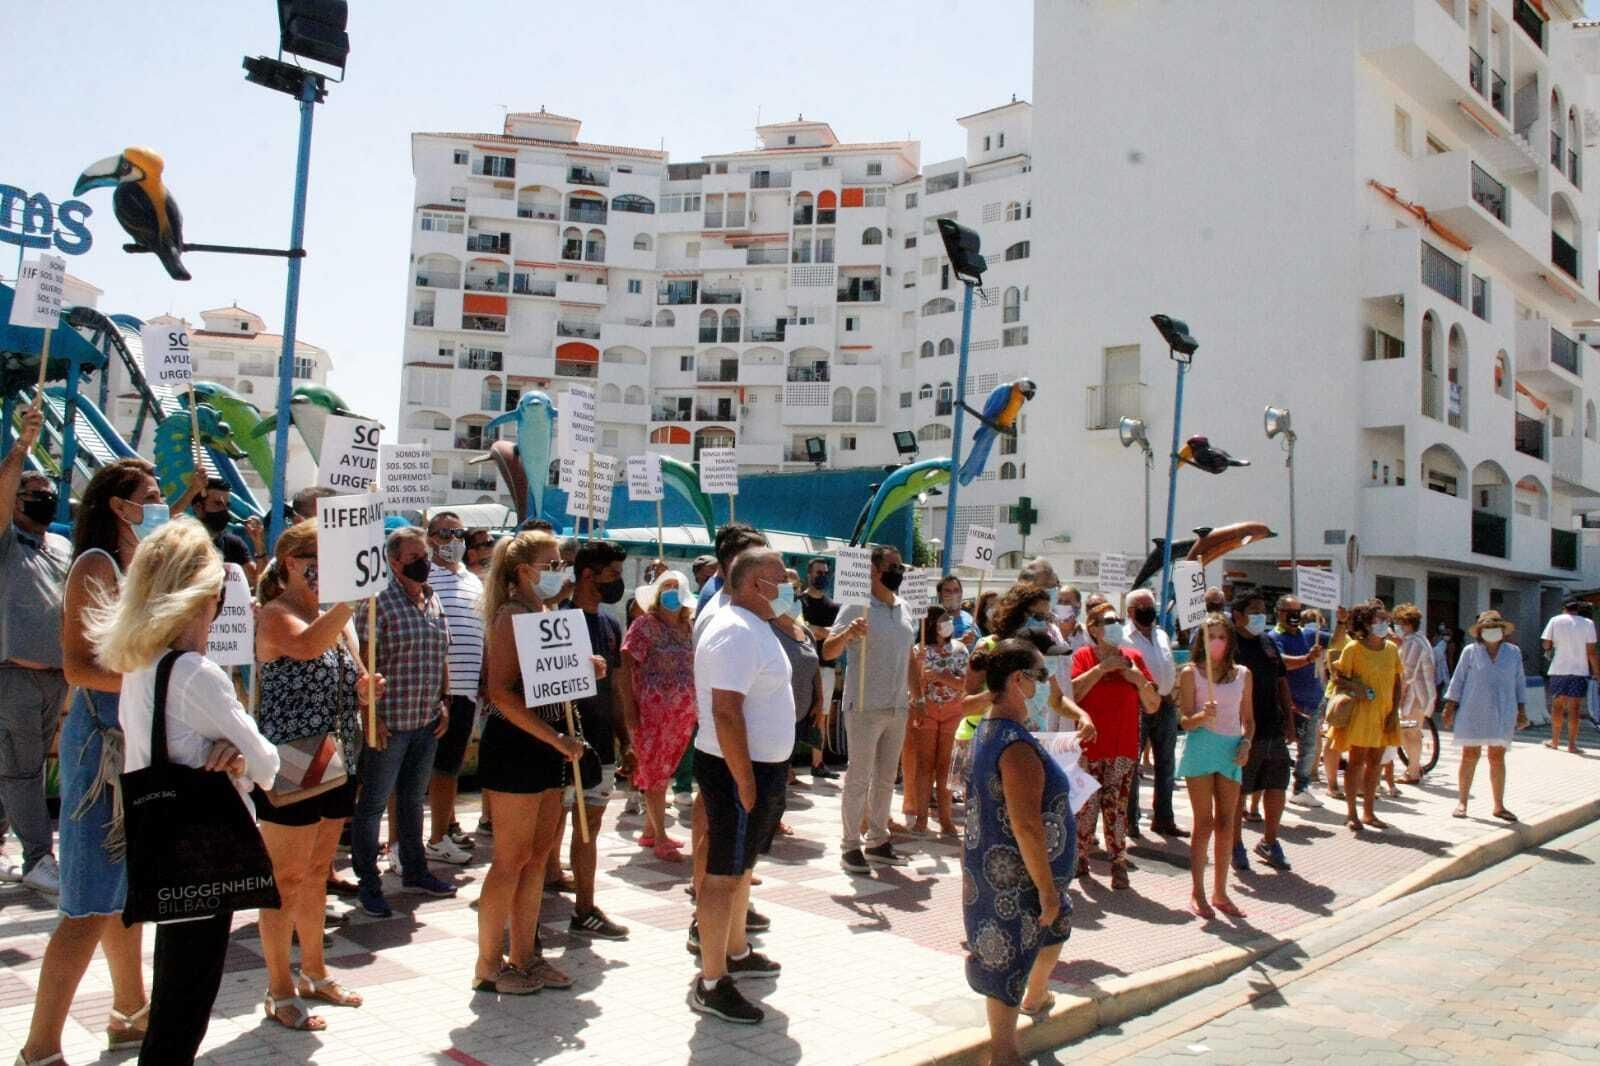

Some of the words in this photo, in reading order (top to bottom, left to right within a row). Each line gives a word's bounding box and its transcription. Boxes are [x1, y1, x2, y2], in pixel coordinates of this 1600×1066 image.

[330, 472, 376, 490] URGE
[223, 606, 246, 616] STROS
[157, 875, 274, 901] GUGGENHEIM
[158, 896, 221, 915] BILBAO
